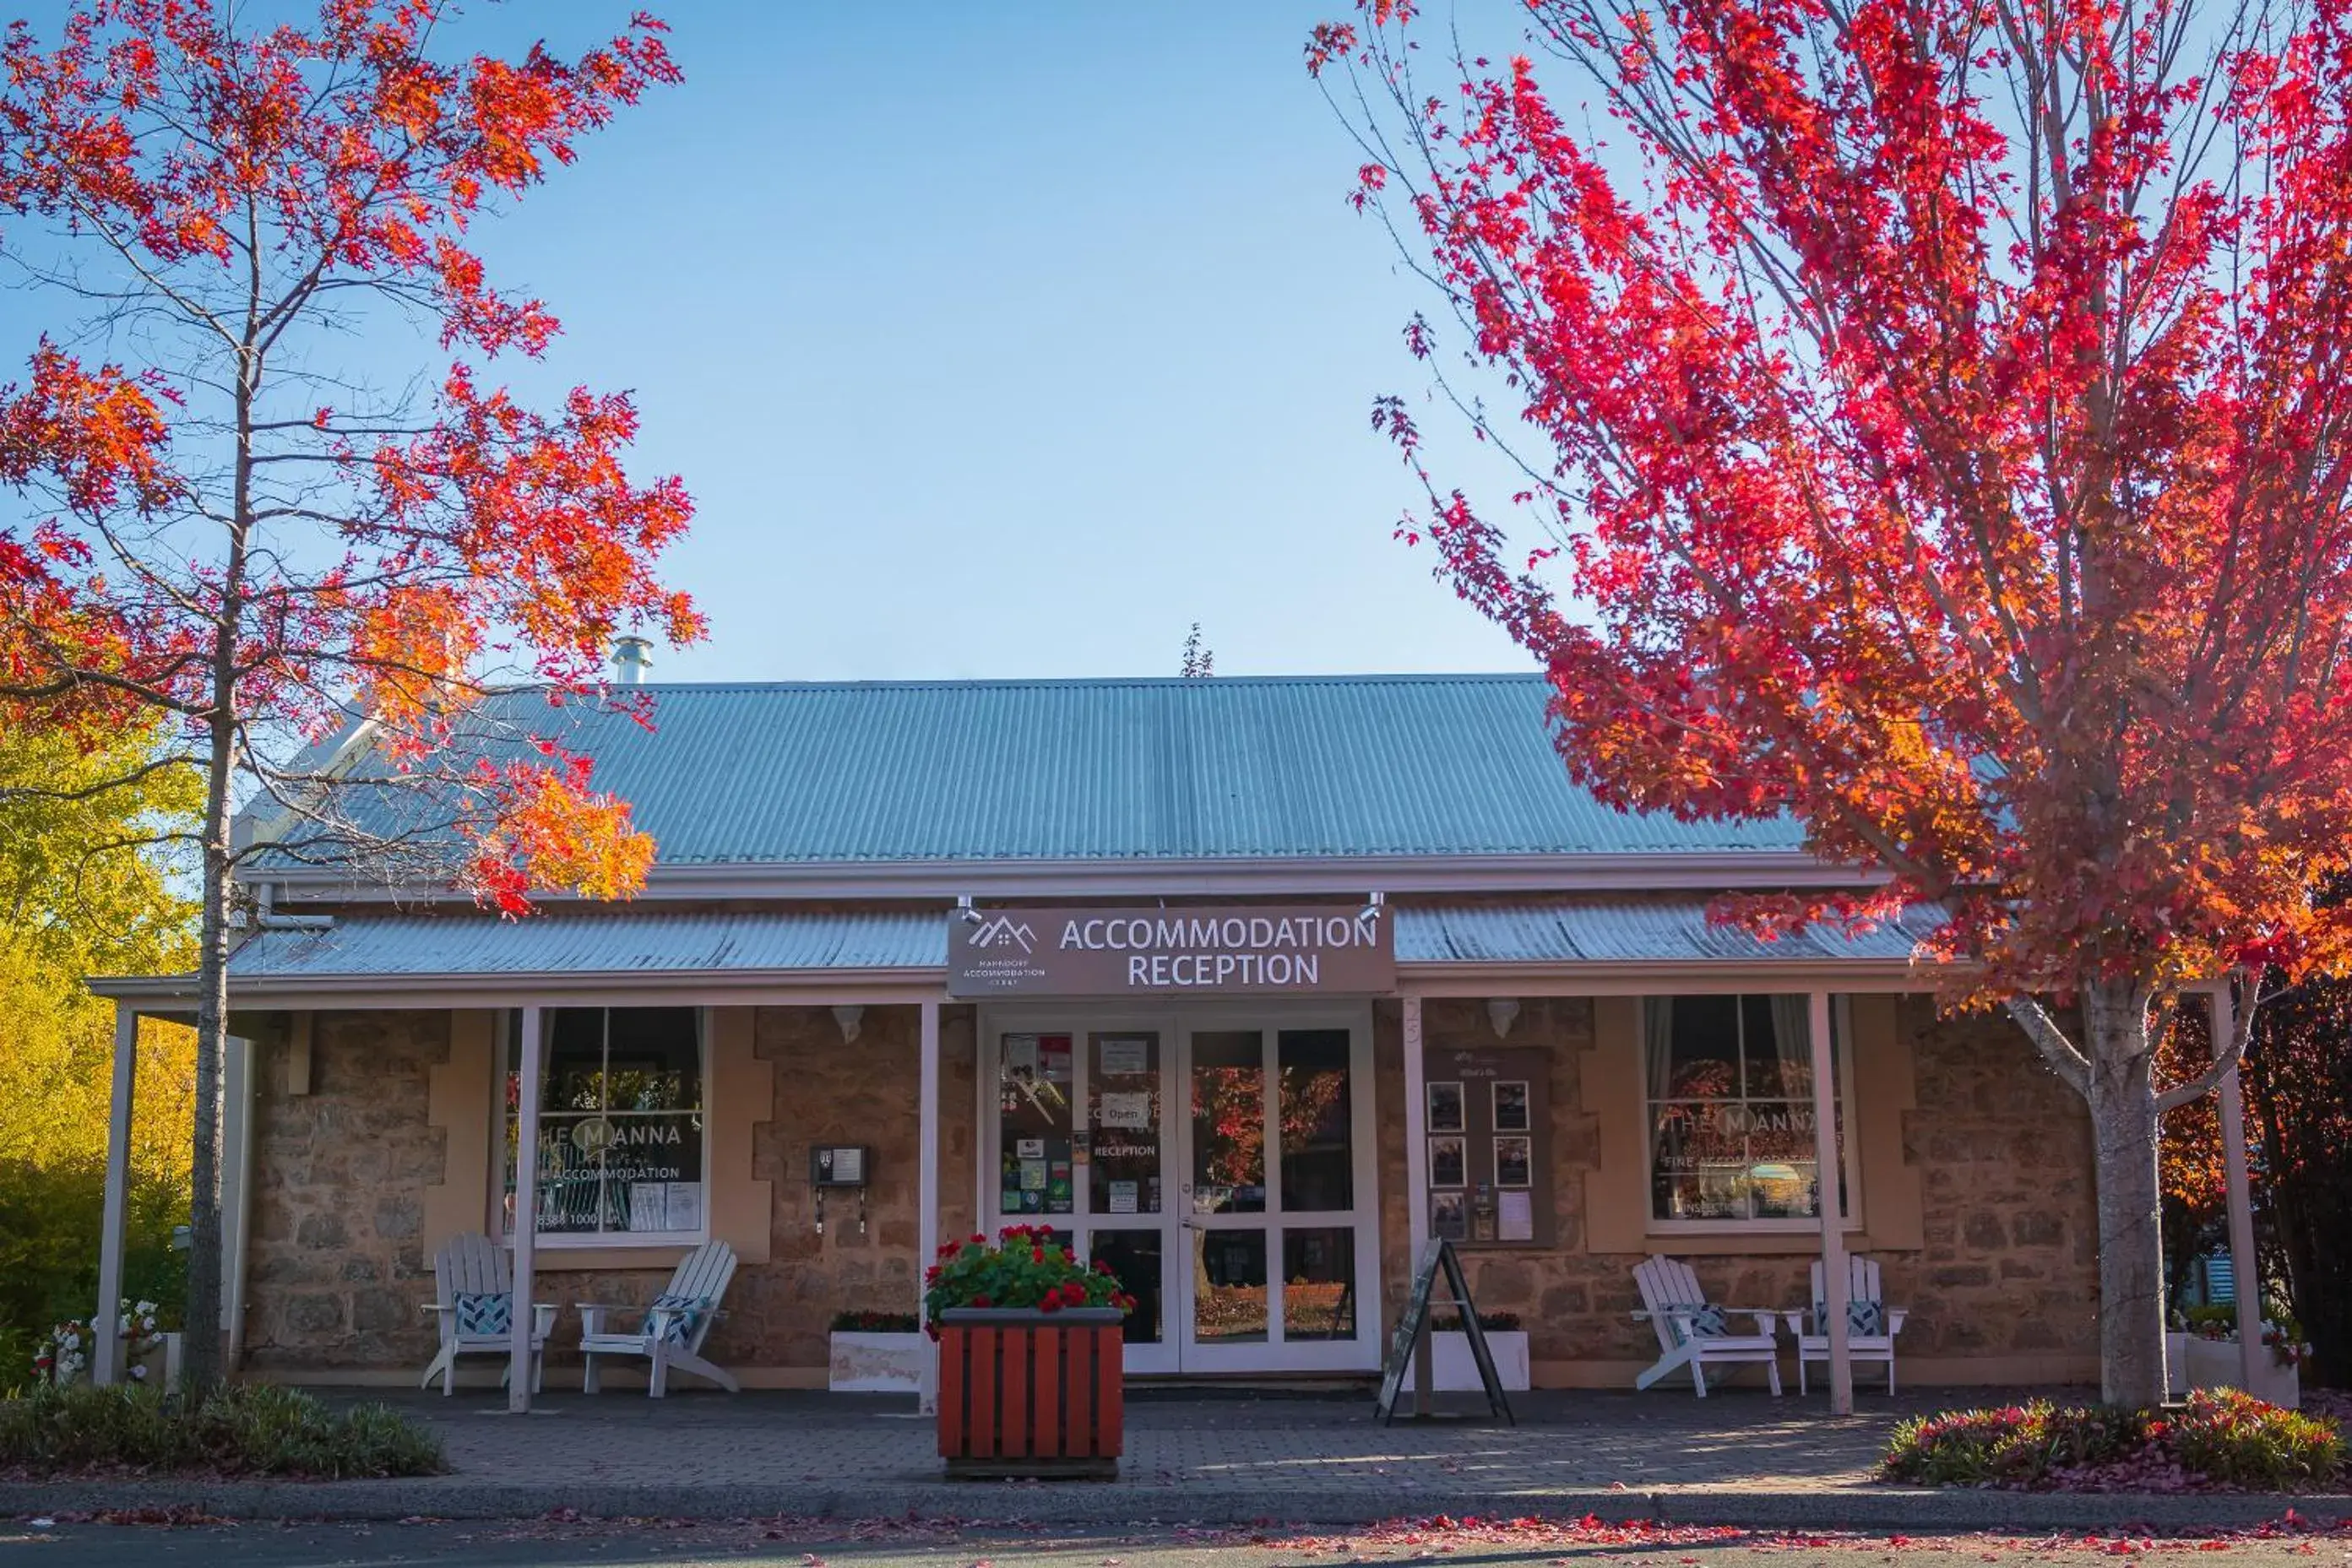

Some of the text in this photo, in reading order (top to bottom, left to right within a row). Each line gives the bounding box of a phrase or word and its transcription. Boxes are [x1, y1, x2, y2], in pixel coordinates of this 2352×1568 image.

[1059, 916, 1377, 950] ACCOMMODATION
[1127, 954, 1318, 986] RECEPTION
[1110, 1110, 1138, 1121] Open
[1669, 1114, 1710, 1133] THE
[538, 1126, 682, 1146] HE MANNA
[1095, 1145, 1155, 1157] RECEPTION
[1665, 1156, 1693, 1168] FINE
[553, 1168, 680, 1180] ACCOMMODATION
[570, 1213, 596, 1224] 1000
